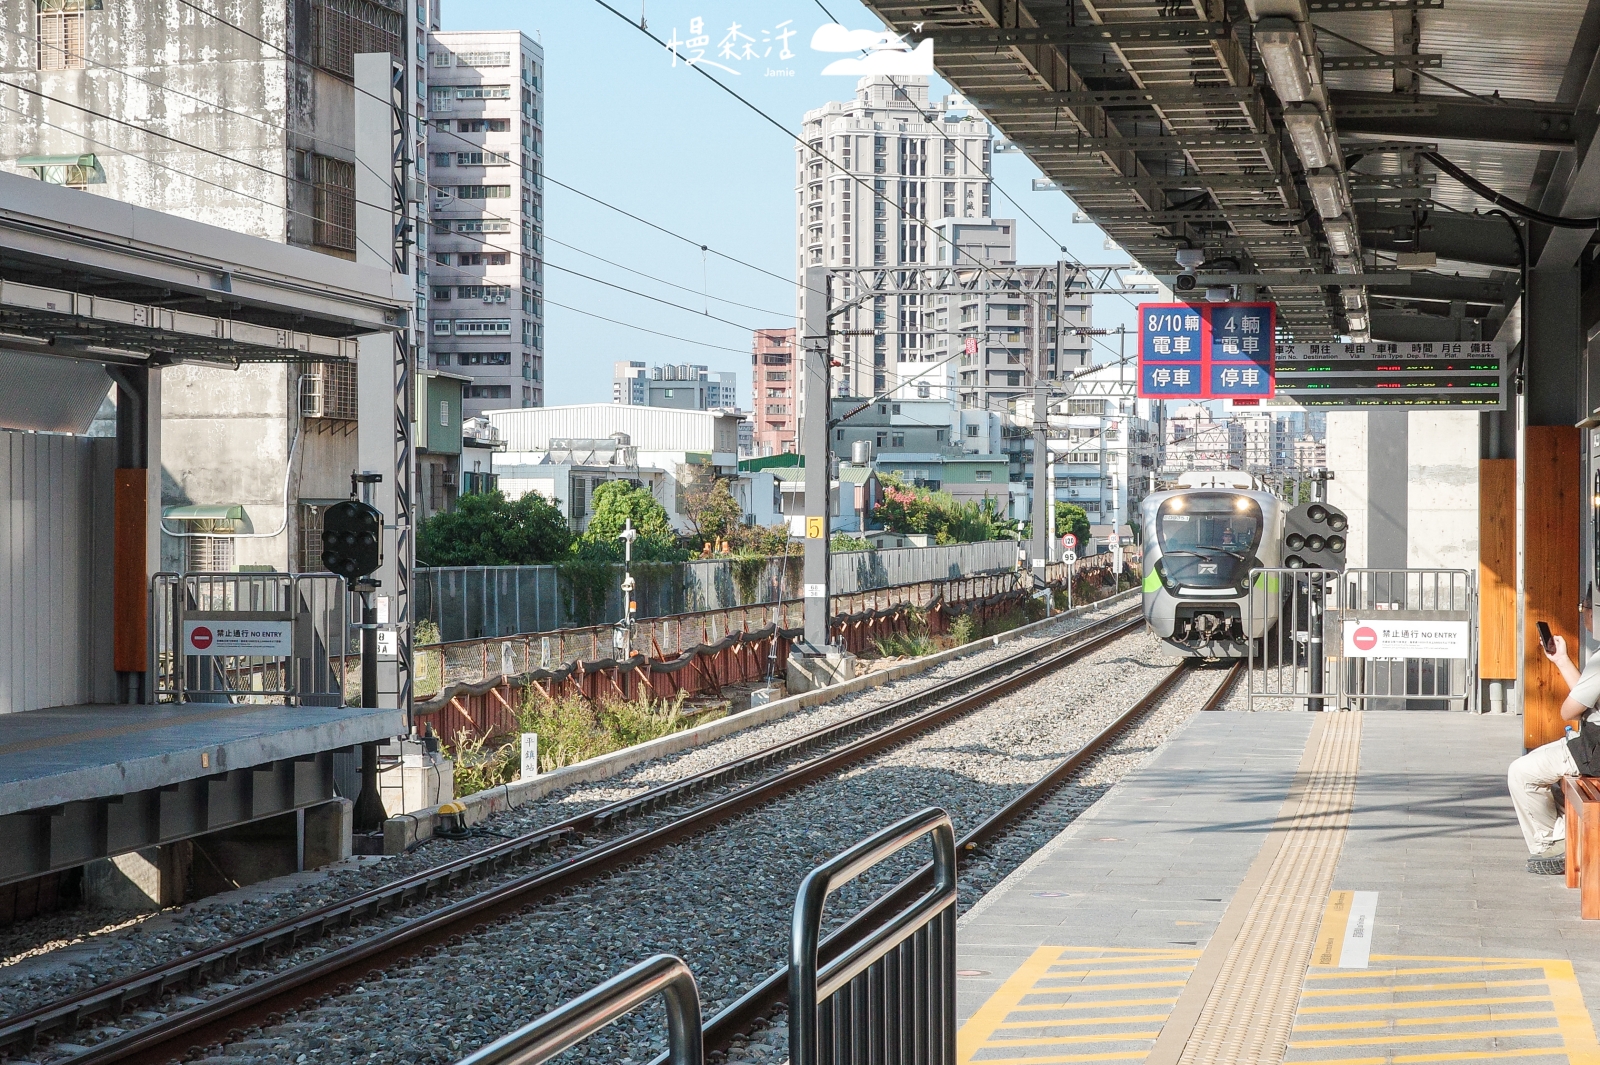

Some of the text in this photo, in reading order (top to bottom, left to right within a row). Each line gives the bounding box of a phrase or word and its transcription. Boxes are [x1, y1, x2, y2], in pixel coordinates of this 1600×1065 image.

[1148, 314, 1200, 332] 8/10 輛
[1224, 316, 1260, 334] 4 輛
[1153, 336, 1191, 354] 電車
[1222, 336, 1260, 354] 電車
[1310, 344, 1331, 354] 開往
[1344, 344, 1366, 354] 經由
[1376, 344, 1398, 353] 車種
[1412, 344, 1432, 353] 時間
[1442, 344, 1461, 353] 月台
[1471, 343, 1492, 352] 備註
[1152, 368, 1191, 387] 停車
[1220, 368, 1260, 387] 停車
[809, 518, 820, 538] 5
[217, 629, 248, 637] 禁止通行
[1382, 630, 1419, 638] 禁止通行
[525, 737, 535, 778] 平鎮站
